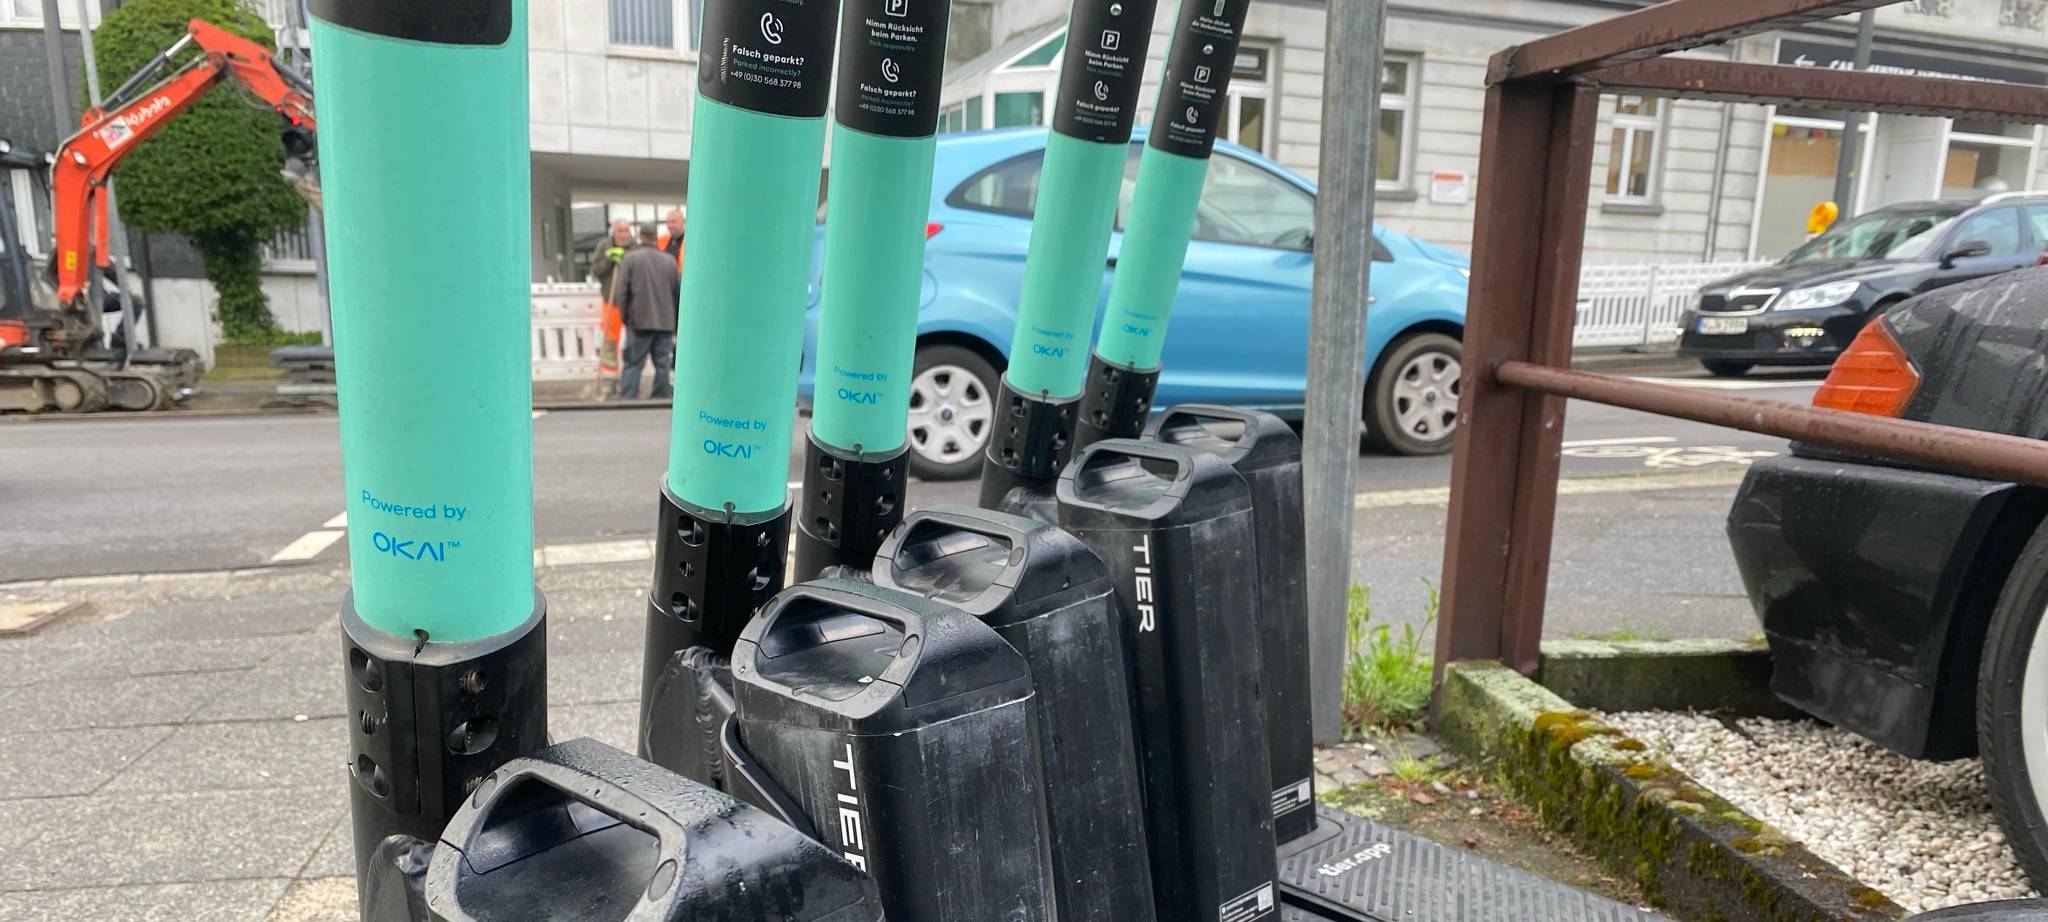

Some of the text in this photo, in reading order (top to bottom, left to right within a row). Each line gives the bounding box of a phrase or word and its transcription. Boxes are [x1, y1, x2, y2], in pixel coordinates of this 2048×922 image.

[866, 19, 923, 33] Nimm Rücksicht
[872, 30, 918, 42] beim Parken.
[732, 45, 804, 66] Falsch geparkt?
[733, 58, 801, 77] Parked incorrectly?
[764, 76, 778, 85] 568
[860, 83, 917, 98] Falsch geparkt?
[834, 365, 888, 382] Powered by
[700, 411, 768, 431] Powered by
[362, 489, 466, 521] Powered by
[1133, 534, 1155, 632] TIER
[1318, 843, 1392, 877] tier.app
